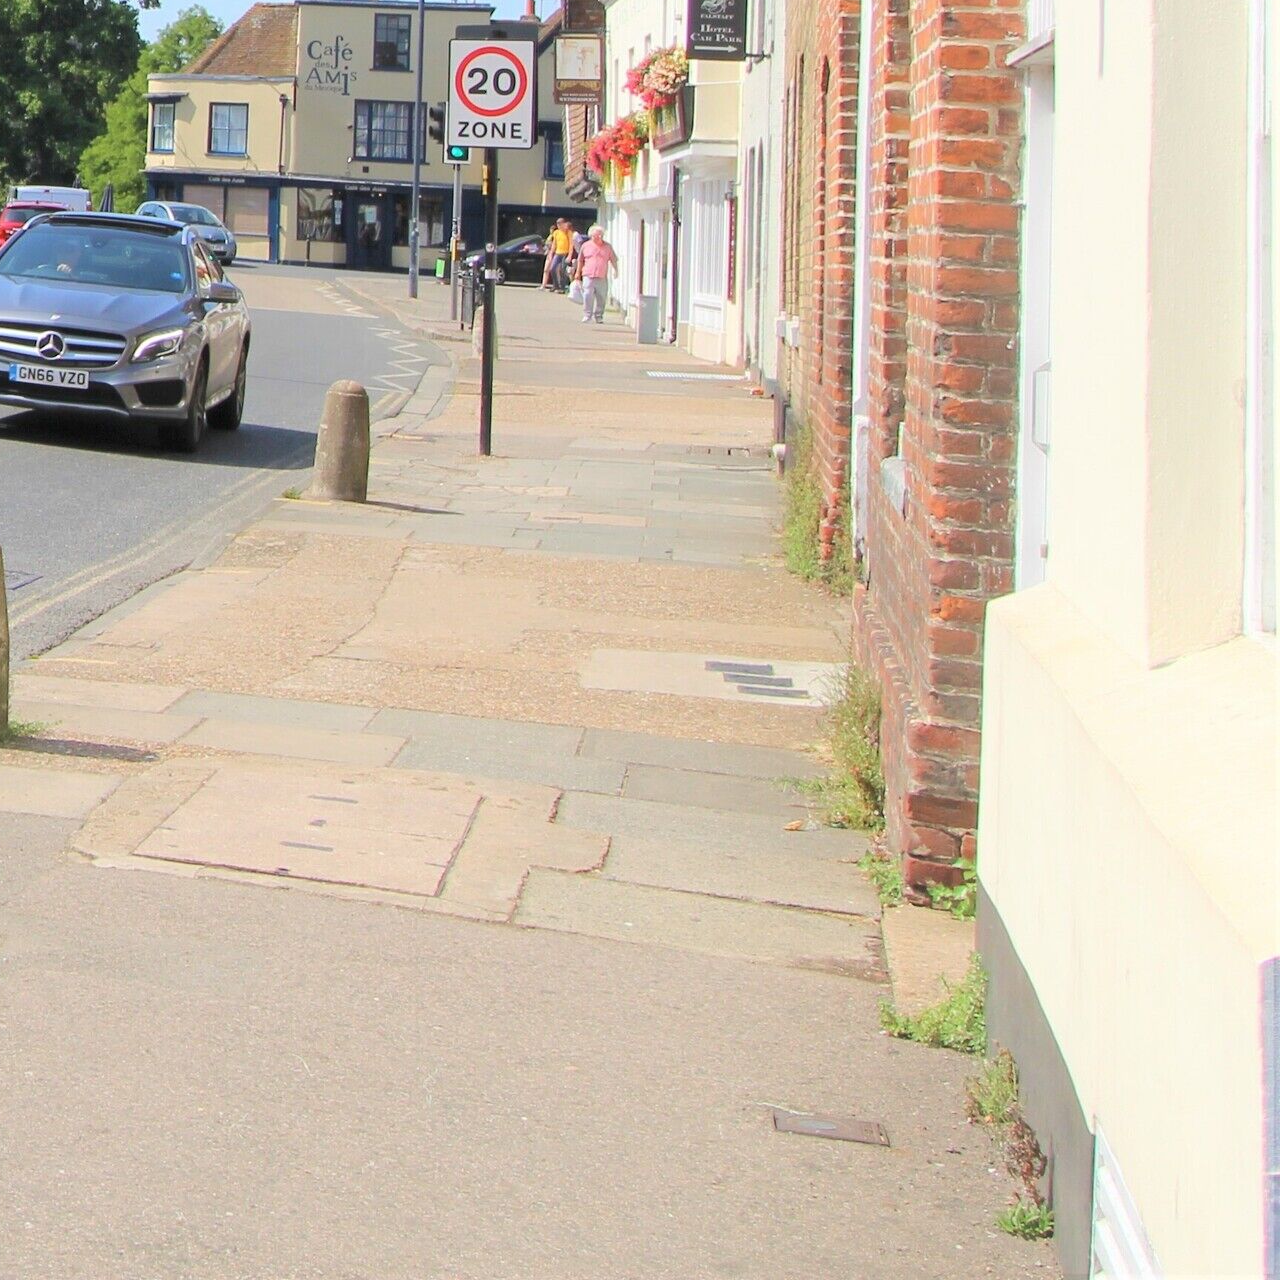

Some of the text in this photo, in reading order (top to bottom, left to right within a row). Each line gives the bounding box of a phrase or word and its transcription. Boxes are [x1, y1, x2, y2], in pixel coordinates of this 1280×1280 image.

[307, 35, 353, 69] Café
[467, 68, 516, 96] 20
[458, 121, 523, 139] ZONE
[20, 366, 86, 385] GN66 VZO
